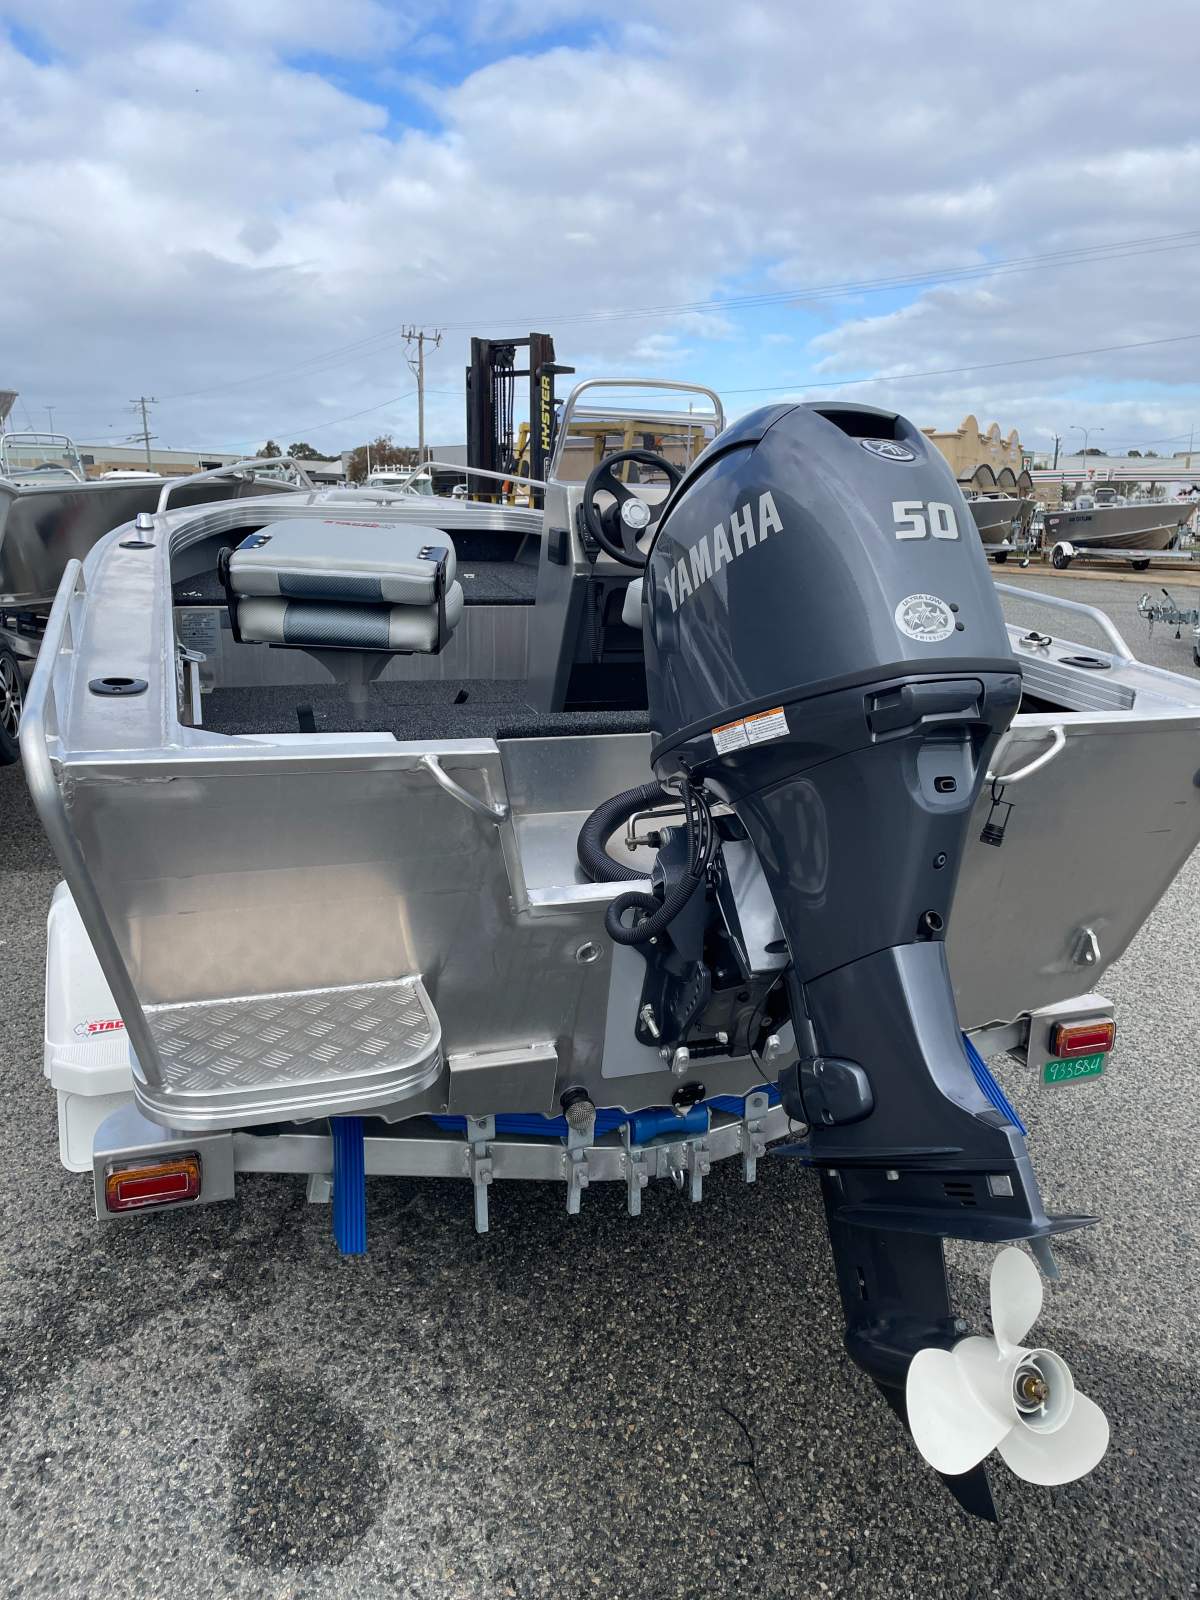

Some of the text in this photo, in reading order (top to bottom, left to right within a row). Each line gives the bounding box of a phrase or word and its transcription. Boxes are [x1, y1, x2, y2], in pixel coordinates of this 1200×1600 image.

[541, 376, 551, 450] HYSTER
[892, 500, 959, 540] 50
[664, 490, 784, 614] YAMAHA
[902, 595, 942, 606] ULTRA LOW
